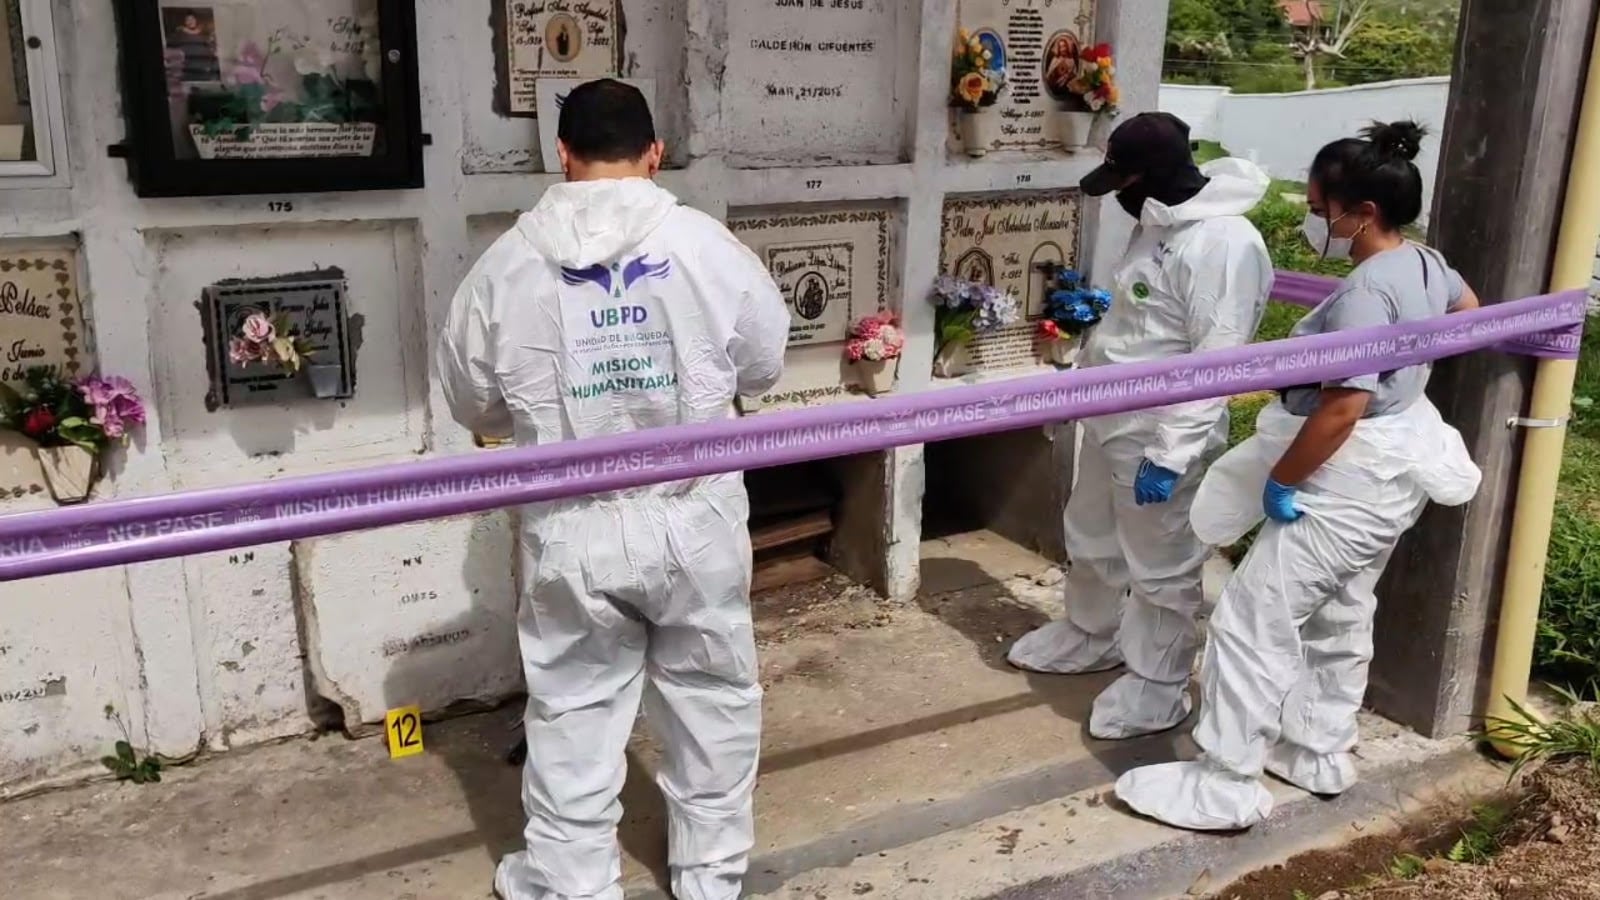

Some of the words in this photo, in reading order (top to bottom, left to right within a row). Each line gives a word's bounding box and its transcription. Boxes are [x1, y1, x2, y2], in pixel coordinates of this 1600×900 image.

[806, 180, 822, 189] 177
[267, 201, 293, 212] 175
[591, 306, 647, 329] UBPD
[609, 333, 621, 342] DE
[7, 339, 46, 363] Junio
[572, 373, 679, 399] HUMANITARIA
[107, 521, 147, 544] NO
[155, 510, 224, 537] PASE
[366, 471, 522, 507] HUMANITARIA
[566, 461, 596, 481] NO
[603, 451, 656, 475] PASE
[693, 432, 758, 462] MISIÓN
[763, 418, 881, 450] HUMANITARIA
[915, 408, 939, 428] NO
[943, 402, 986, 423] PASE
[1015, 388, 1068, 413] MISIÓN
[1071, 374, 1168, 403] HUMANITARIA
[1193, 368, 1214, 386] NO
[1217, 362, 1251, 383] PASE
[1275, 348, 1318, 372] MISIÓN
[1319, 339, 1396, 367] HUMANITARIA
[1415, 333, 1430, 350] NO
[1430, 329, 1457, 347] PASE
[391, 713, 420, 748] 12
